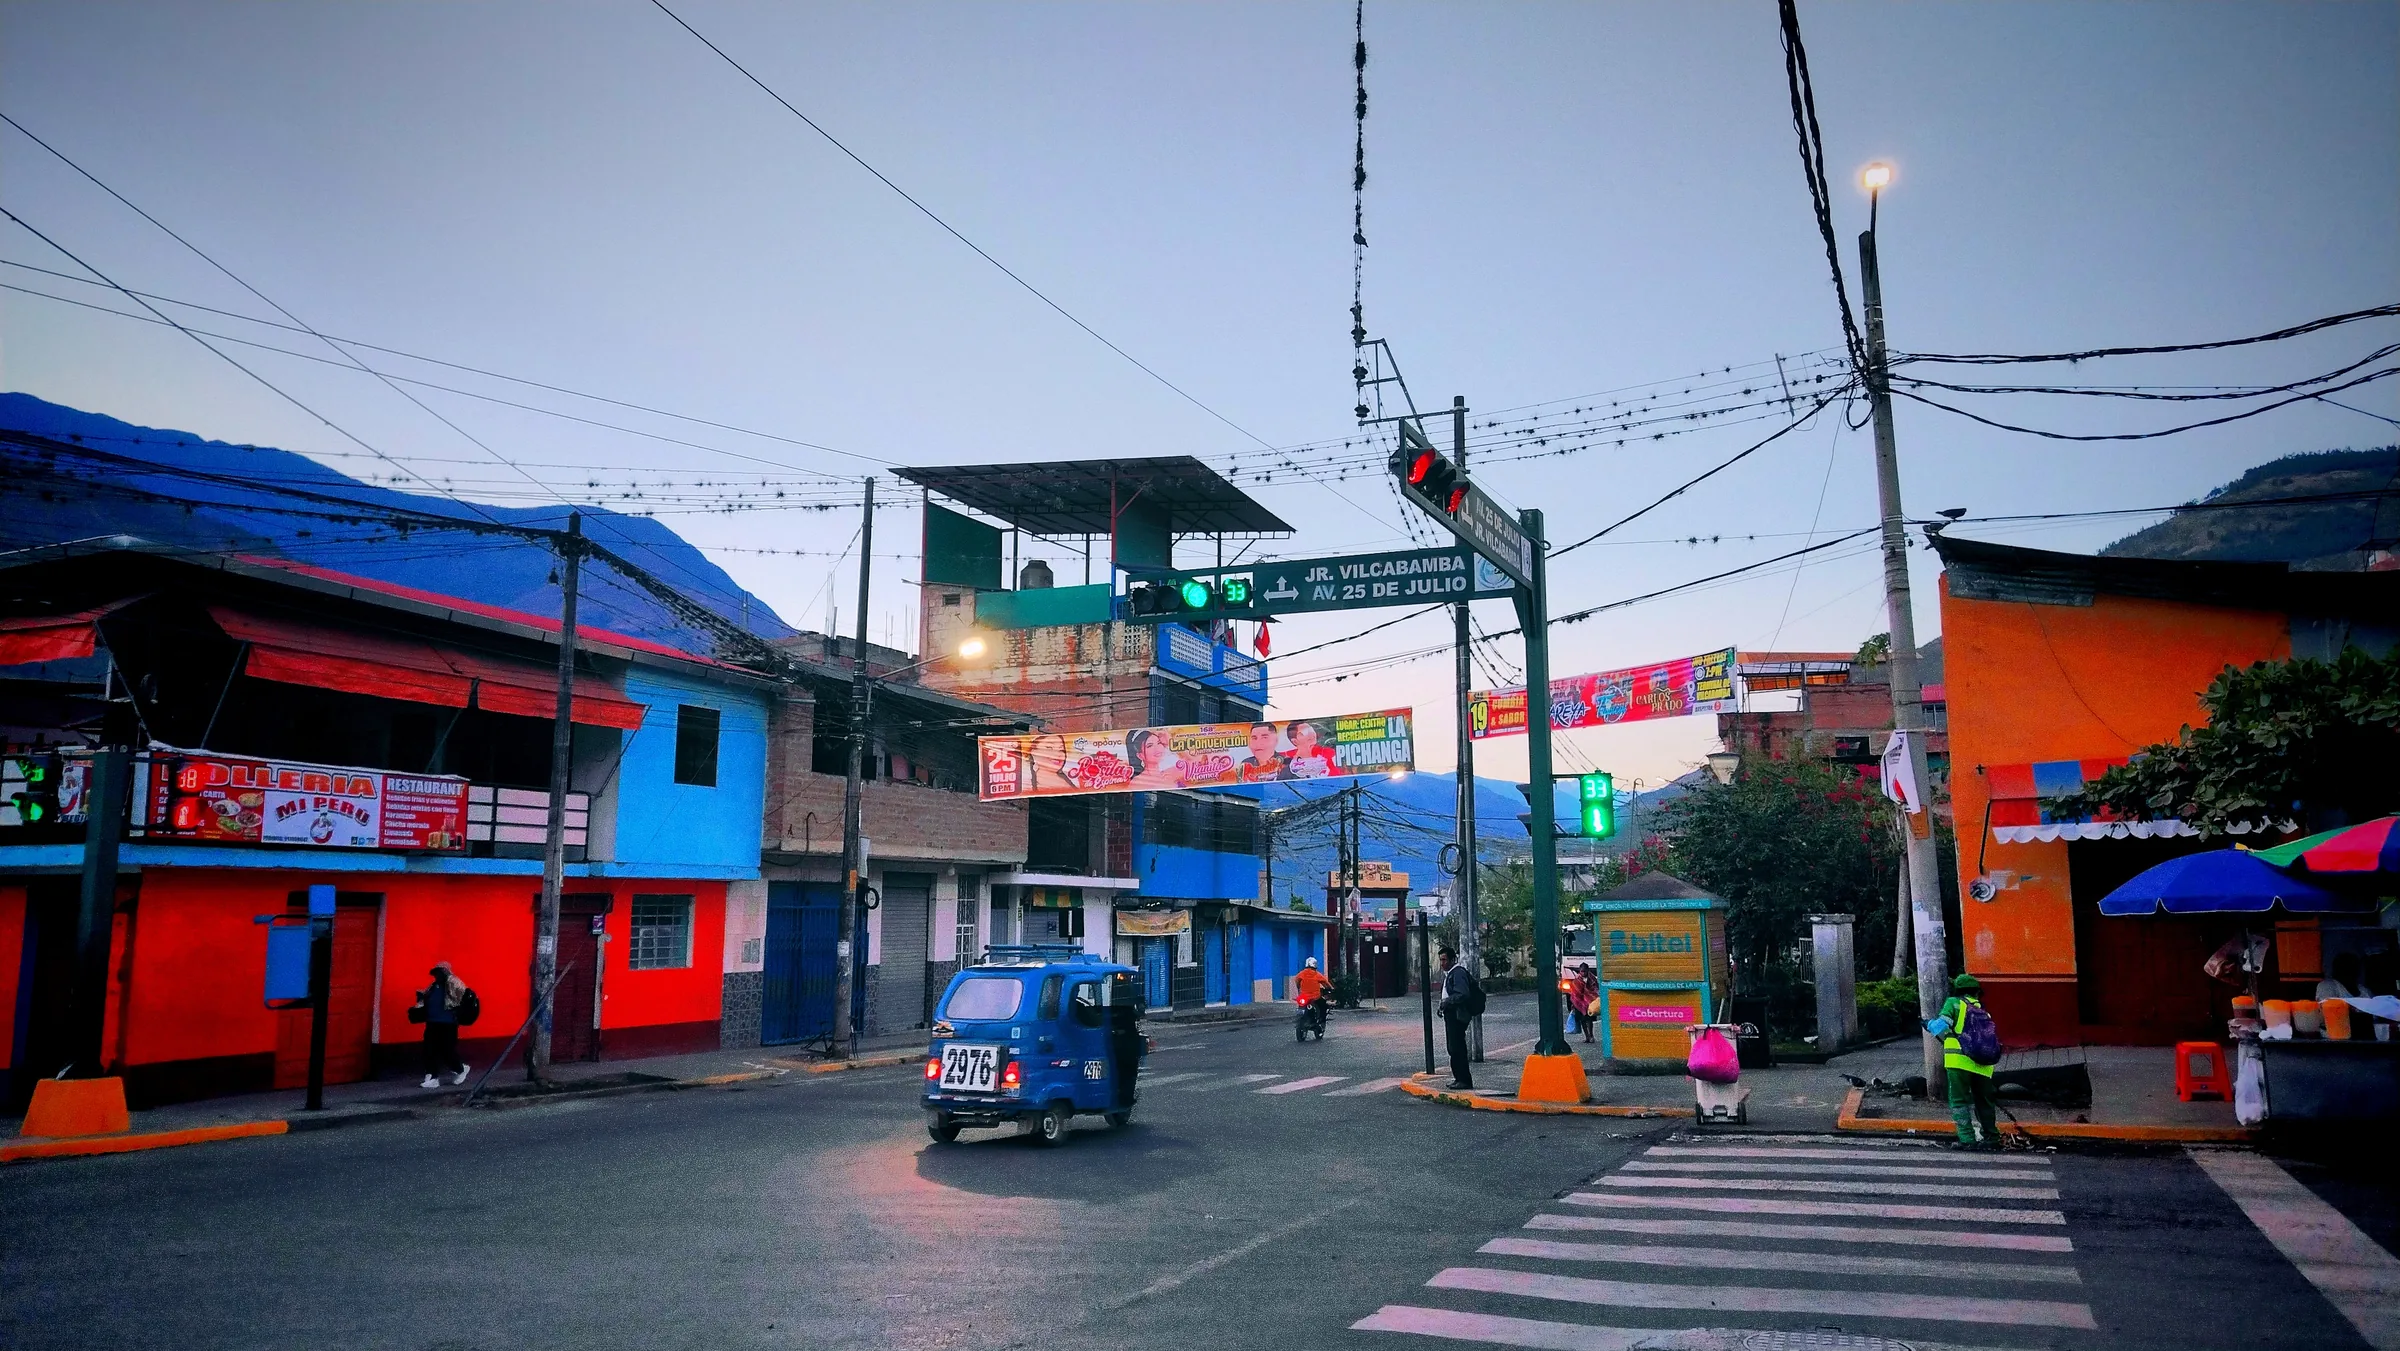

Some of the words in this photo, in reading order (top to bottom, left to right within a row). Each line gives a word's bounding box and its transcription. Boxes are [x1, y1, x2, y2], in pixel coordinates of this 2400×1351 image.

[1485, 508, 1493, 525] 25
[1494, 515, 1503, 533] DE
[1504, 522, 1520, 549] JULIO
[1474, 521, 1485, 542] JR.
[1485, 529, 1520, 571] VILCABAMBA
[1304, 567, 1334, 583] JR.
[1338, 555, 1466, 579] VILCABAMBA
[1226, 583, 1246, 602] 33
[1311, 583, 1337, 602] AV.
[1343, 583, 1366, 600] 25
[1372, 581, 1399, 598] DE
[1404, 575, 1467, 596] JULIO
[1491, 696, 1525, 711] CUMBIA
[1635, 692, 1671, 706] CARLOS
[1651, 699, 1683, 713] PRADO
[1335, 718, 1360, 731] LUGAR:
[1360, 716, 1386, 730] CENTRO
[1470, 701, 1488, 731] 19
[1490, 717, 1497, 726] &
[1498, 711, 1525, 726] SABOR
[1336, 727, 1386, 743] RECREACIONAL
[1387, 715, 1407, 738] LA
[1169, 738, 1186, 752] LA
[1335, 739, 1412, 768] PICHANGA
[987, 749, 1017, 773] 25
[386, 777, 463, 796] RESTAURANT
[989, 772, 1017, 784] JULIO
[1585, 779, 1608, 799] 33
[276, 798, 307, 822] MI
[1380, 873, 1391, 881] EBA
[1631, 932, 1692, 953] bitel
[944, 1048, 992, 1087] 2976
